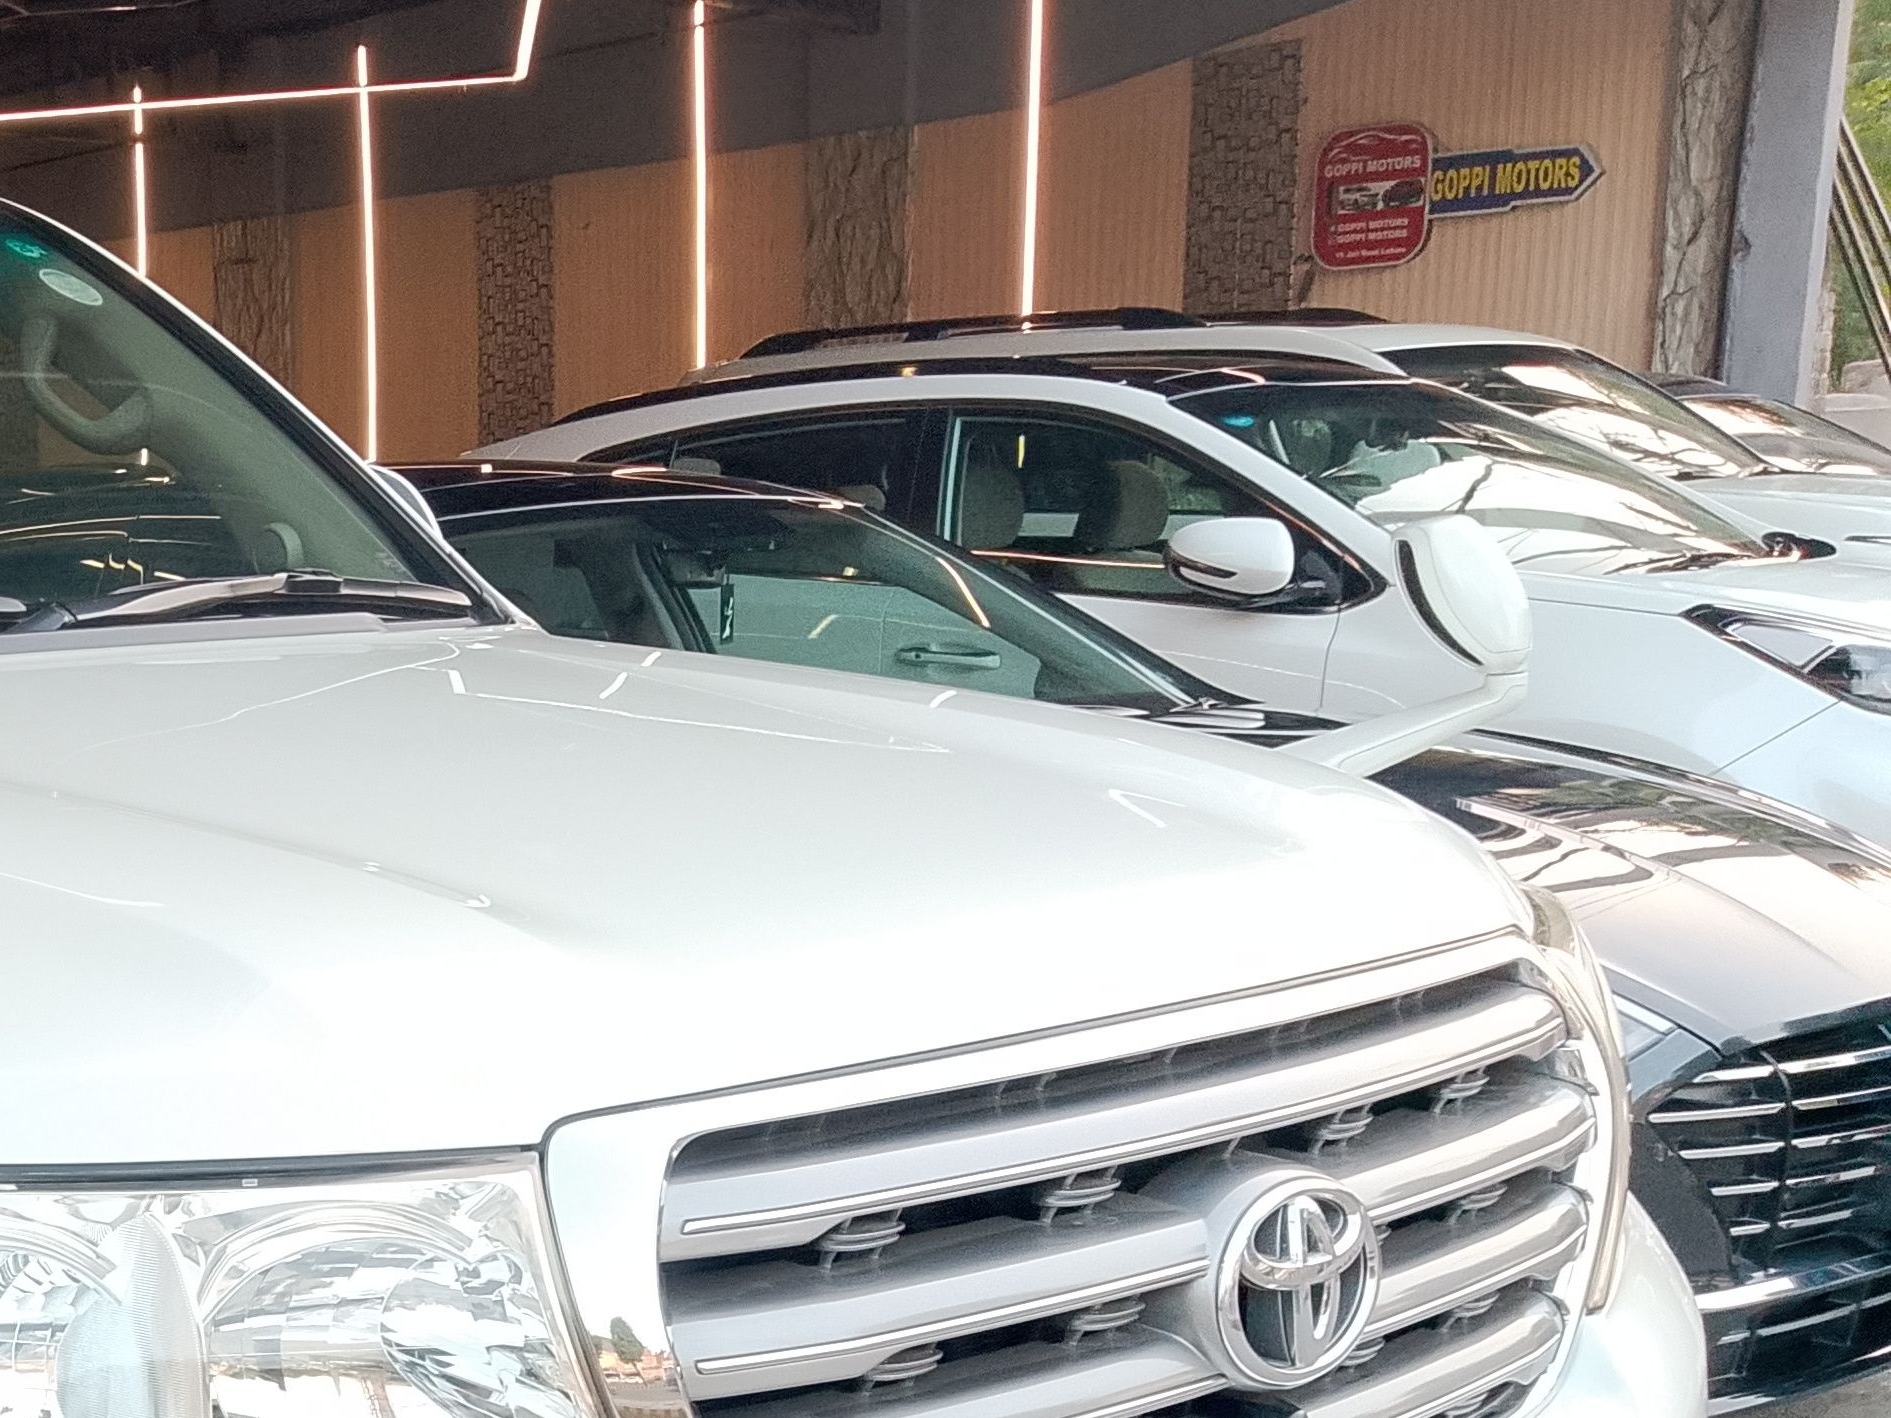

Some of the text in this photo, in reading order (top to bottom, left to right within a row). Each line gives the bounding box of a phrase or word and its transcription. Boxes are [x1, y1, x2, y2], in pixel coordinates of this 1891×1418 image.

[1324, 155, 1421, 178] GOPPI MOTORS
[1431, 156, 1582, 202] GOPPI MOTORS
